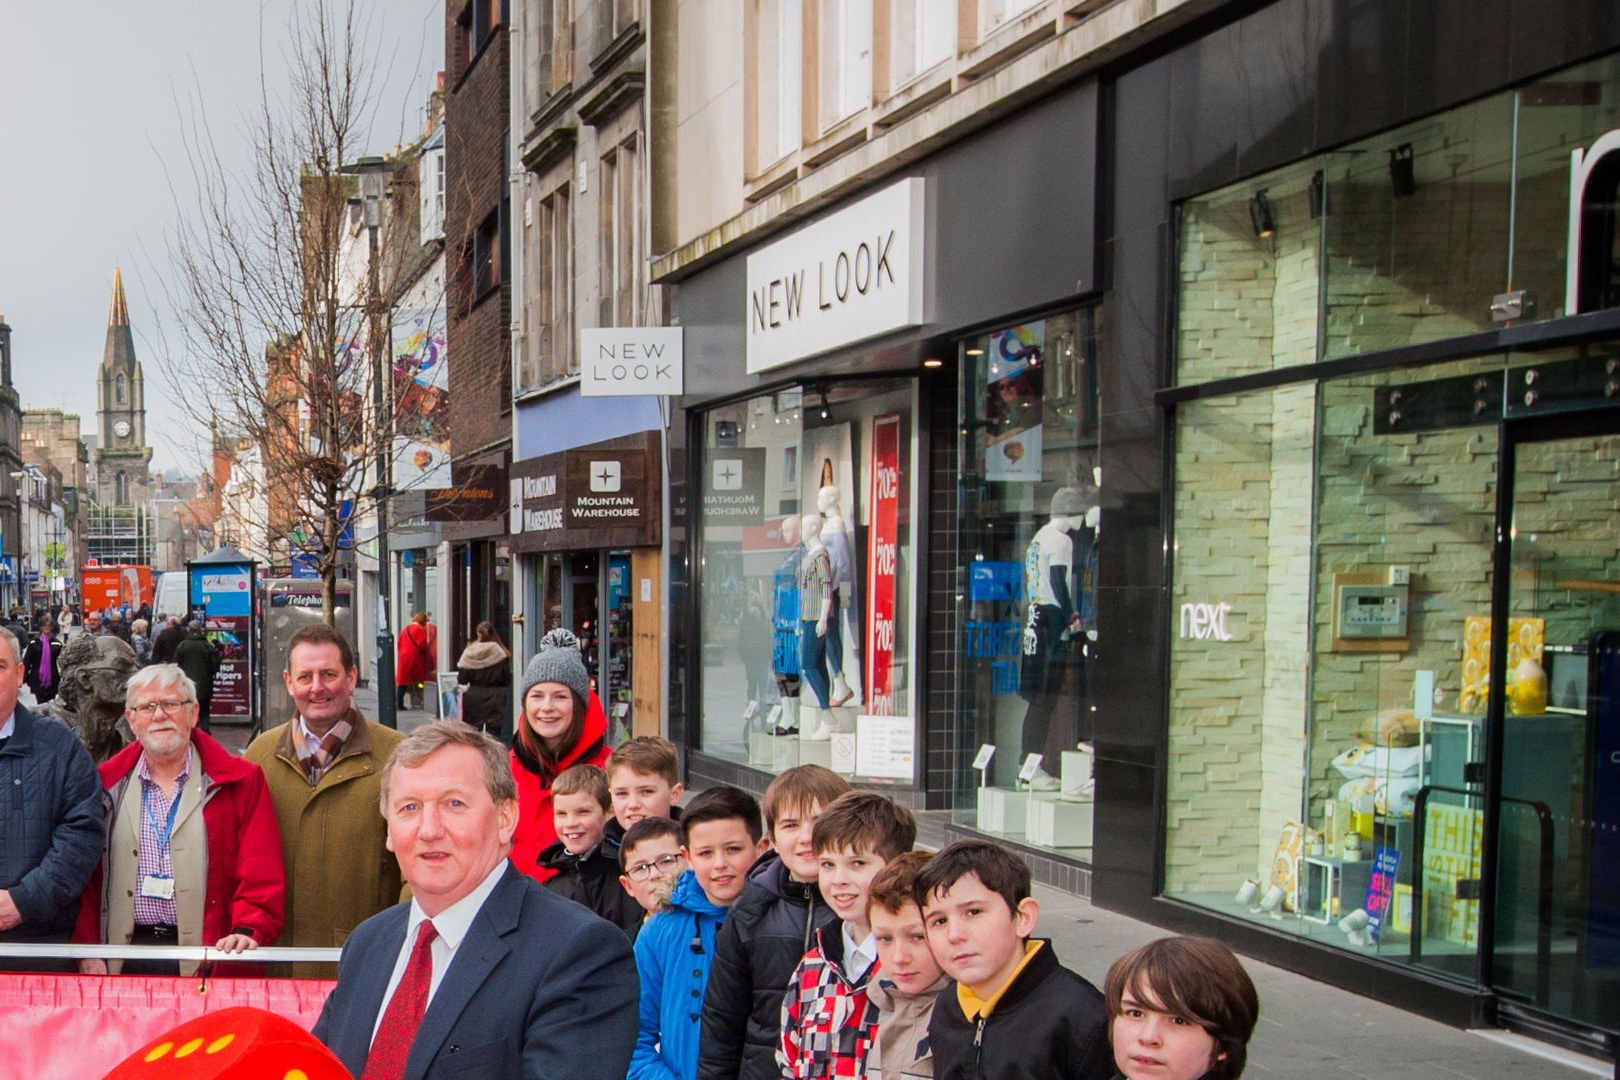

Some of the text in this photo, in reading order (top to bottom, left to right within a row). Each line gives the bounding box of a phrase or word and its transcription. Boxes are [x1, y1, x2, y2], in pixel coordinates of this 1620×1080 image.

[752, 230, 896, 335] NEW LOOK
[599, 342, 666, 360] NEW
[593, 364, 672, 381] LOOK
[524, 475, 557, 499] MOUNTAIN
[577, 497, 634, 506] MOUNTAIN
[524, 507, 564, 531] WAREHOUSE
[571, 508, 640, 517] WAREHOUSE
[287, 594, 322, 607] Telepho
[1180, 602, 1235, 642] next
